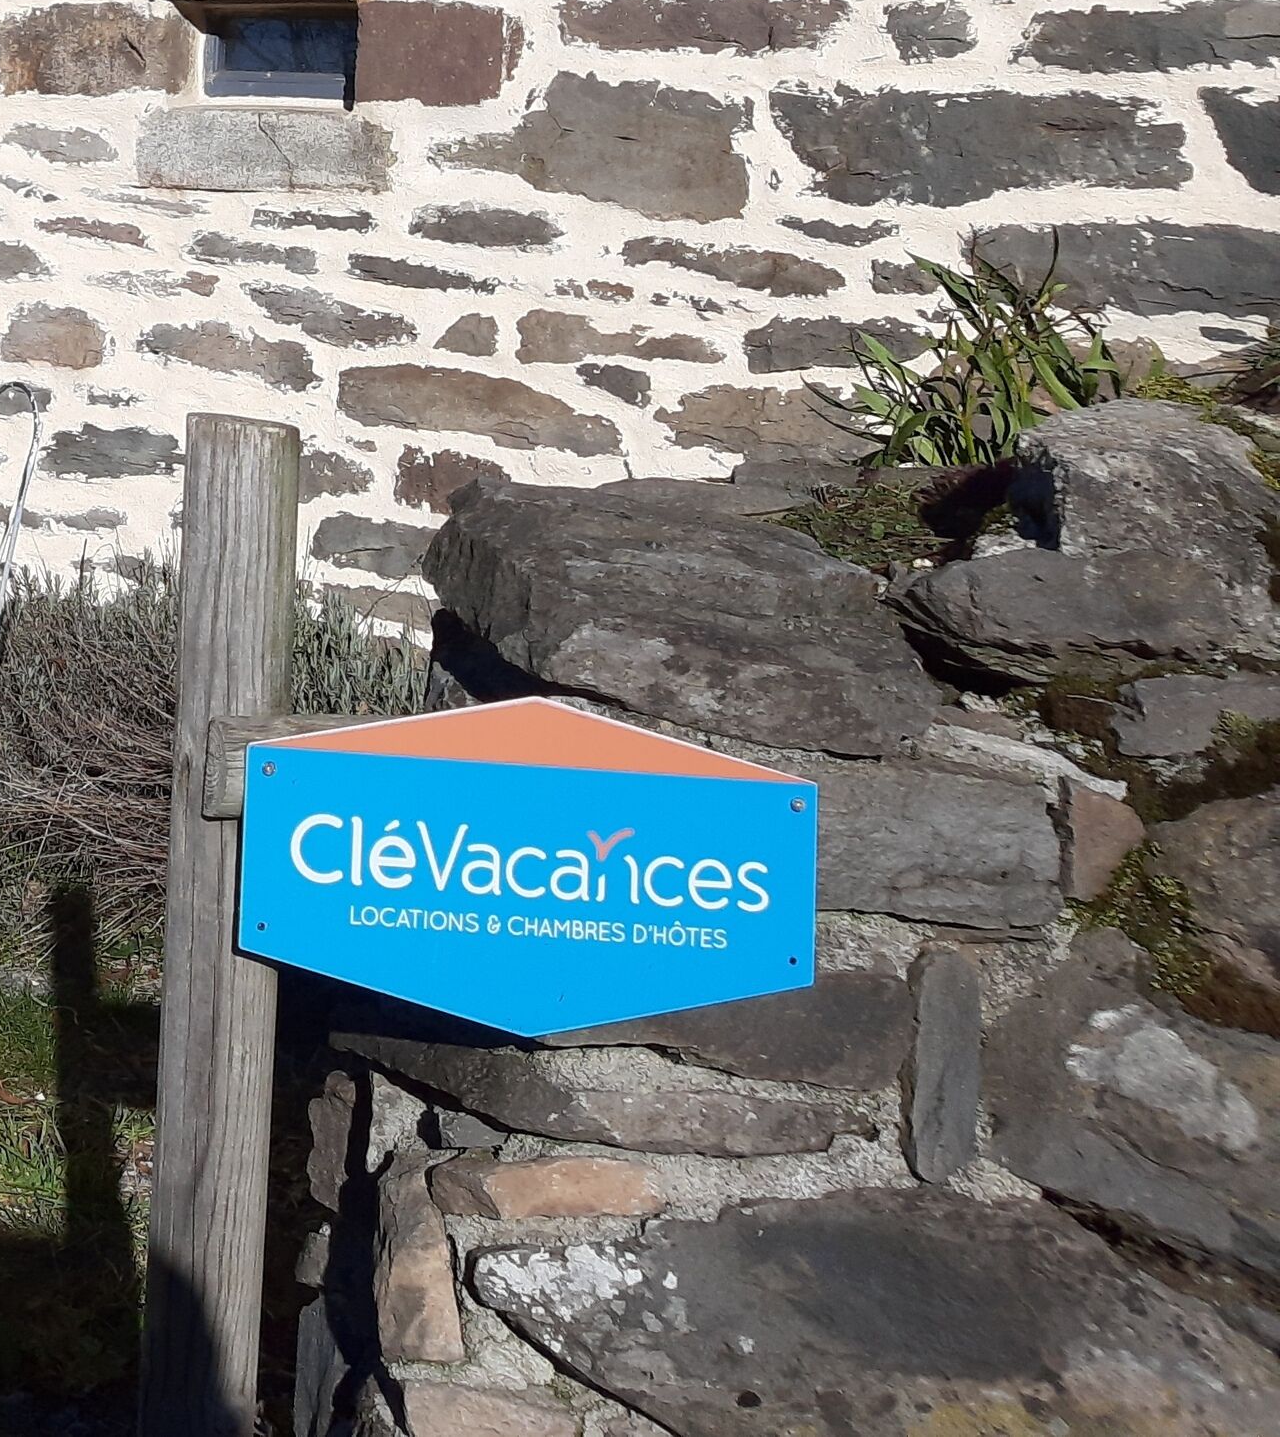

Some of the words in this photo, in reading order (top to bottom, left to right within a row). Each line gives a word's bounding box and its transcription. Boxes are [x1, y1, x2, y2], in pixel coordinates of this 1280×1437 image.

[289, 812, 771, 913] CléVacances
[349, 905, 480, 934] LOCATIONS
[486, 913, 502, 935] &
[506, 915, 626, 943] CHAMBRES
[632, 921, 728, 950] D'HÔTES
